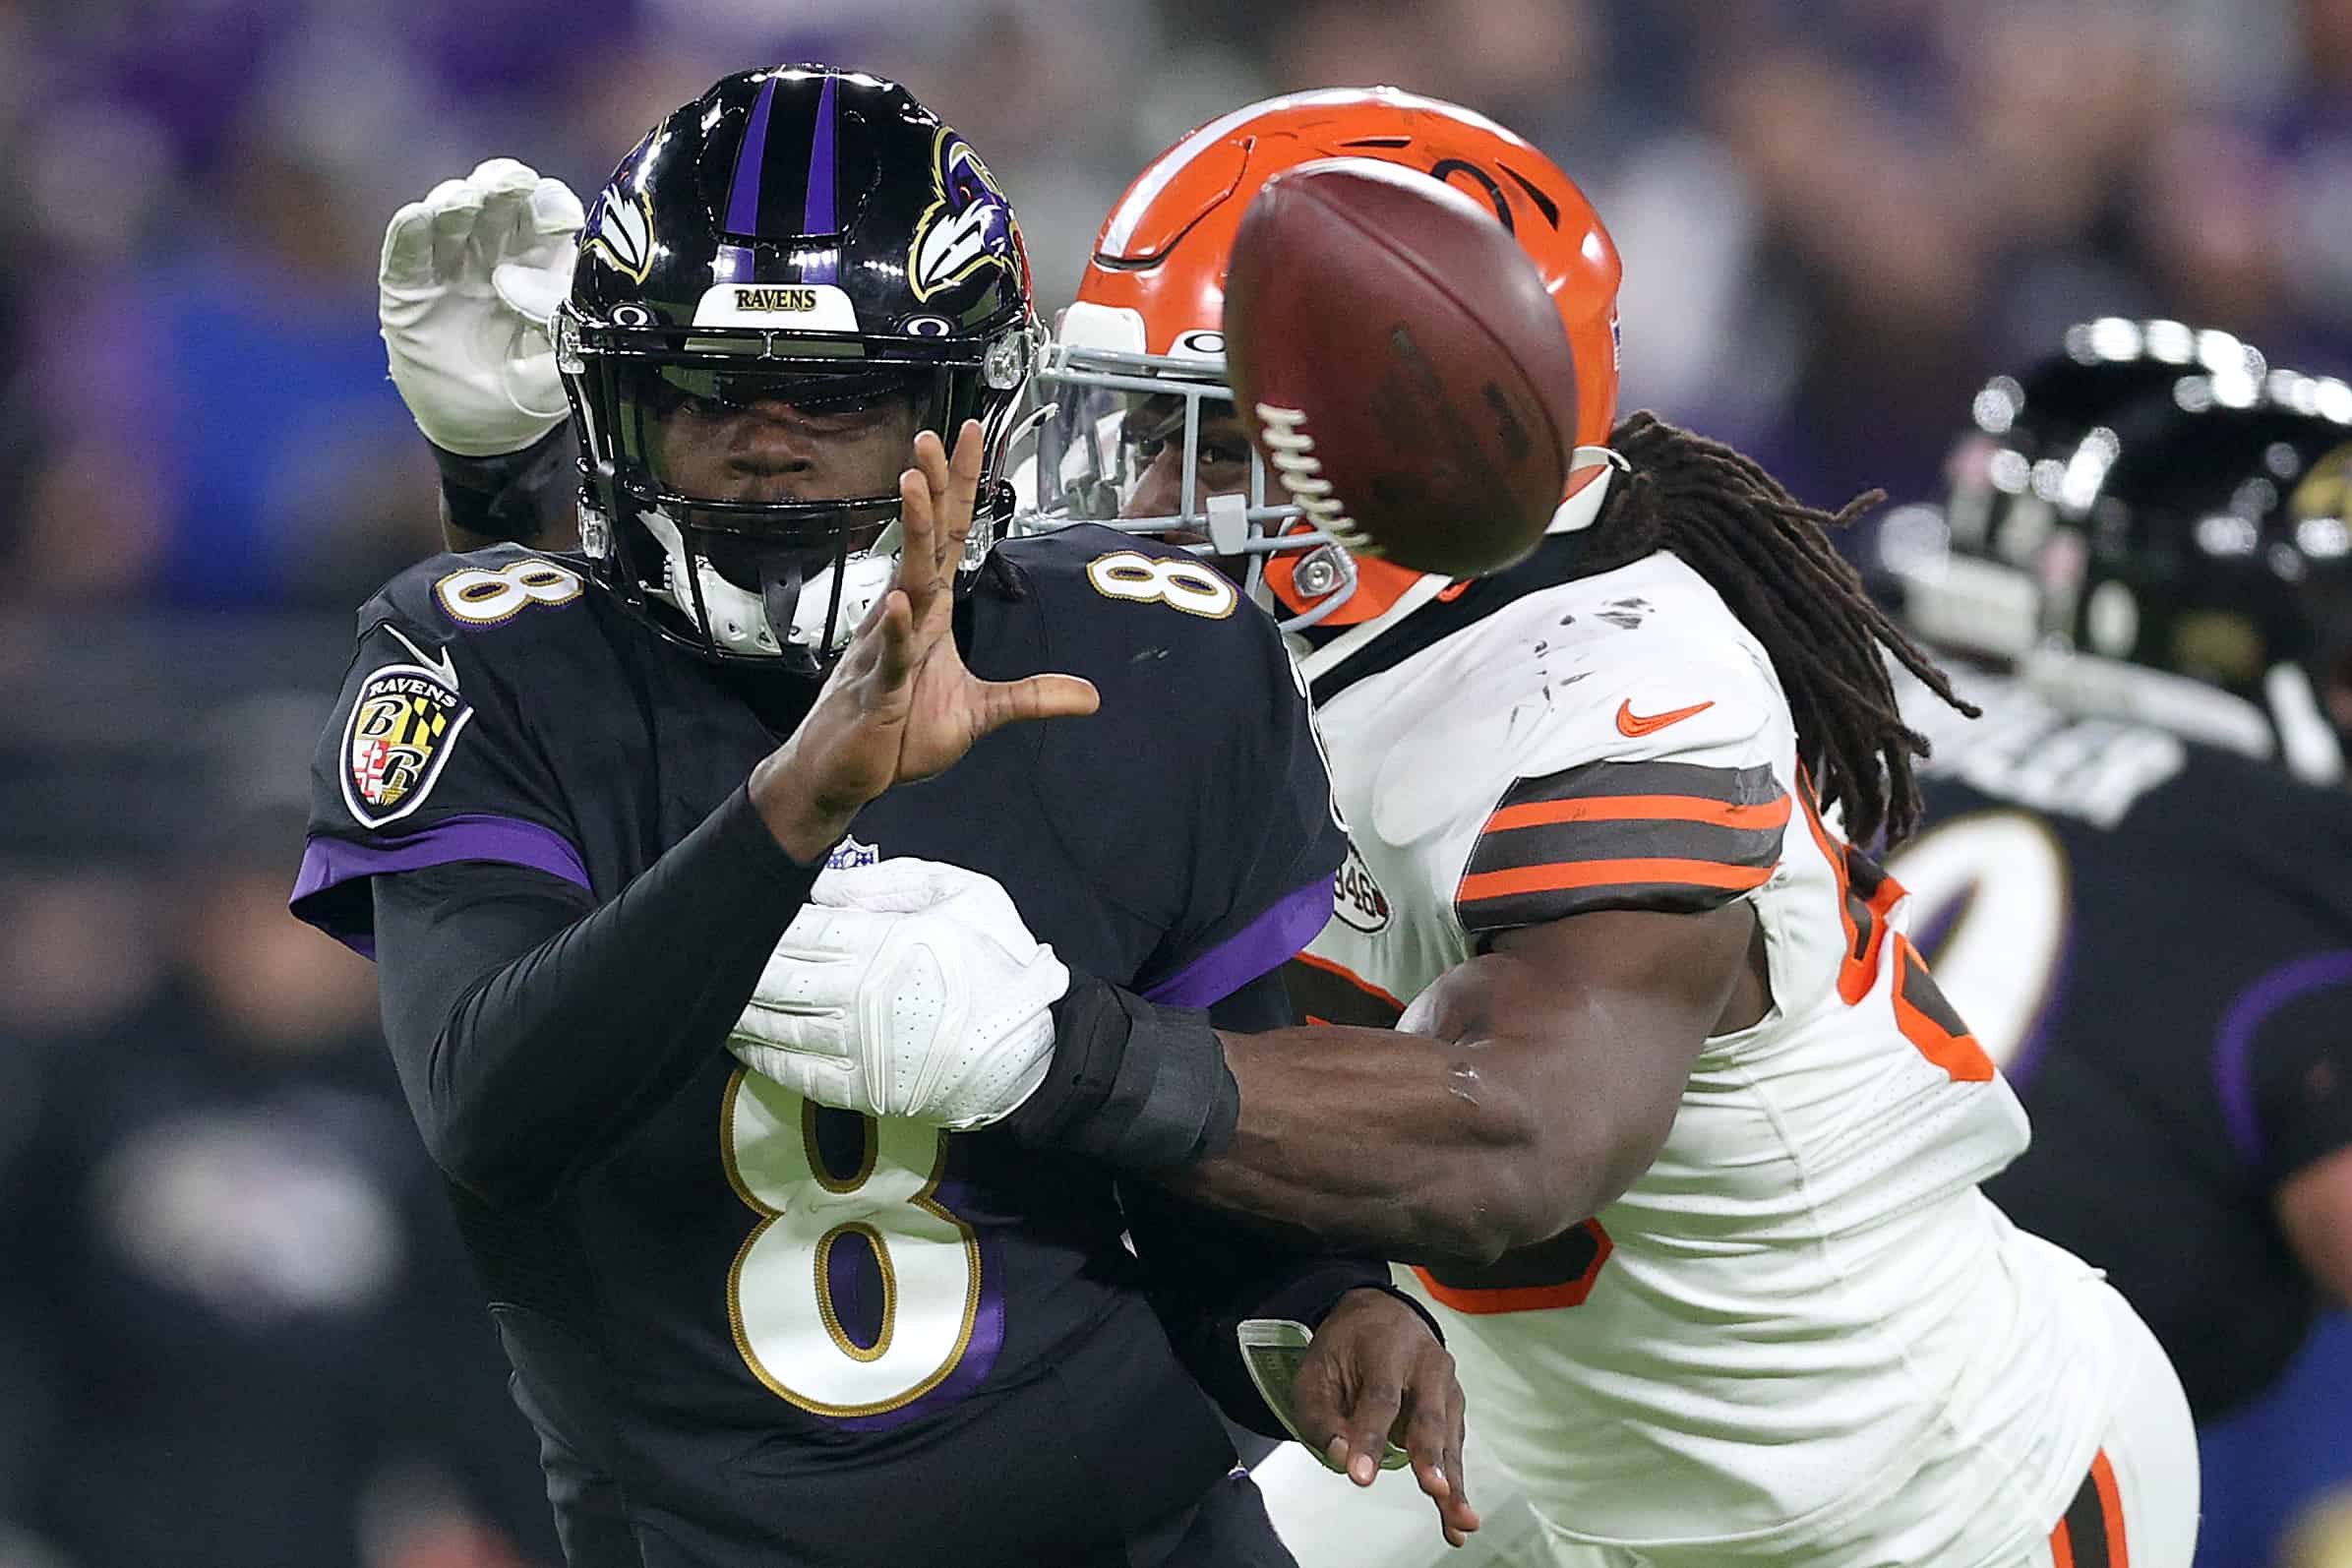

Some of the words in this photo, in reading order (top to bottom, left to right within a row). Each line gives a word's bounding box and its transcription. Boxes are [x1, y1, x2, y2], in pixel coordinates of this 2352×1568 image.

[735, 288, 816, 313] RAVENS
[433, 558, 584, 628] 8
[1086, 550, 1238, 621] 8
[368, 677, 457, 708] RAVENS
[361, 697, 404, 738] B
[382, 746, 428, 791] R
[1333, 865, 1376, 918] 946
[720, 1064, 986, 1417] 8
